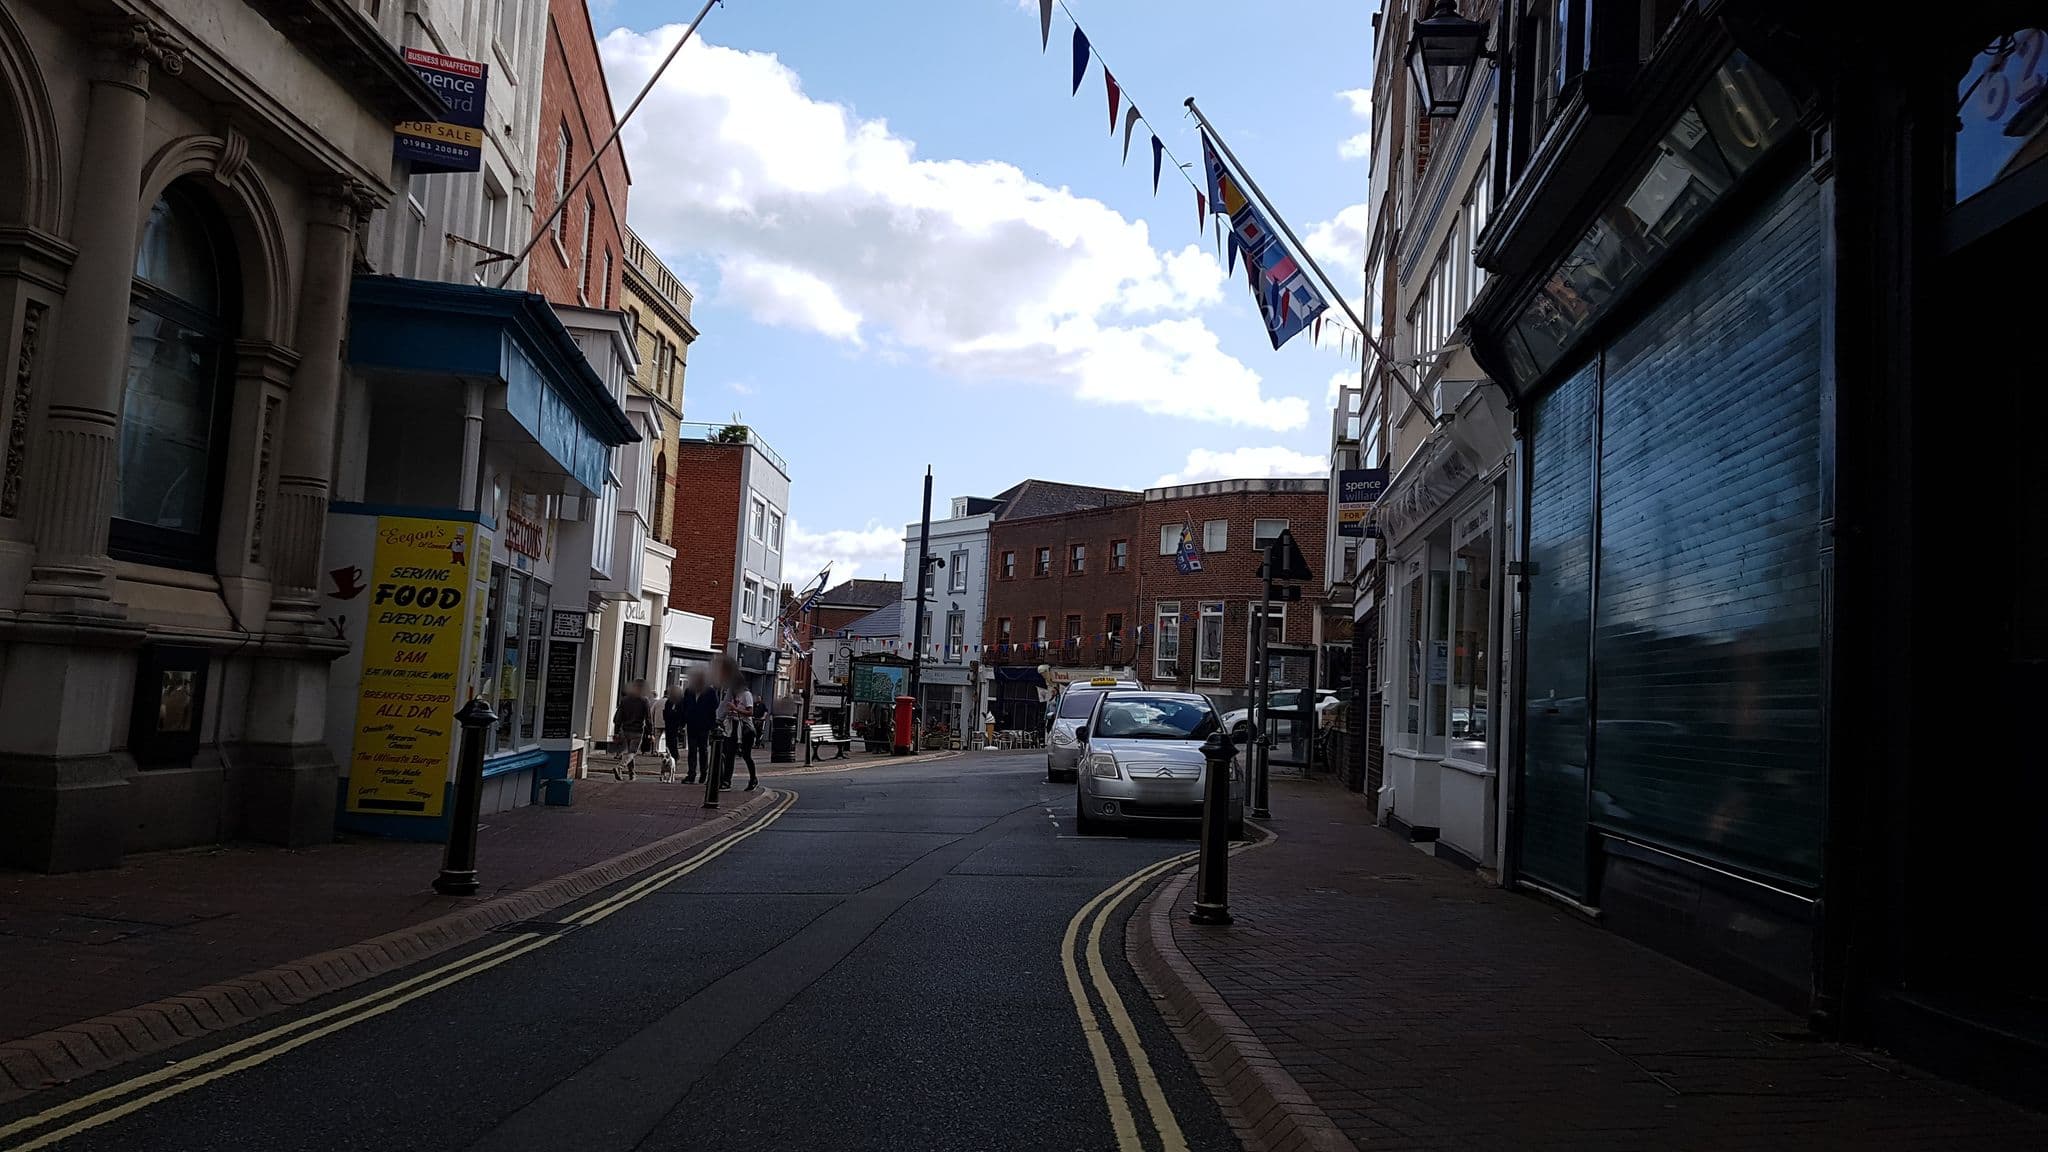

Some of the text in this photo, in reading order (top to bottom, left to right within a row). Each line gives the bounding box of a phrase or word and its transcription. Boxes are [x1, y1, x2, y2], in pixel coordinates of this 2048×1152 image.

[407, 52, 481, 74] BUSINESS UNAFFECTED
[404, 121, 471, 141] FOR SALE
[1345, 480, 1381, 492] spence
[390, 567, 450, 582] SERVING
[374, 583, 461, 609] FOOD
[378, 611, 452, 627] EVERY DAY
[392, 631, 435, 645] FROM
[365, 667, 383, 676] EAT
[406, 671, 429, 679] TAKE
[363, 690, 451, 703] BREAKFAST SERVED
[376, 703, 439, 719] ALL DAY
[357, 752, 443, 768] The Ultimate Burger
